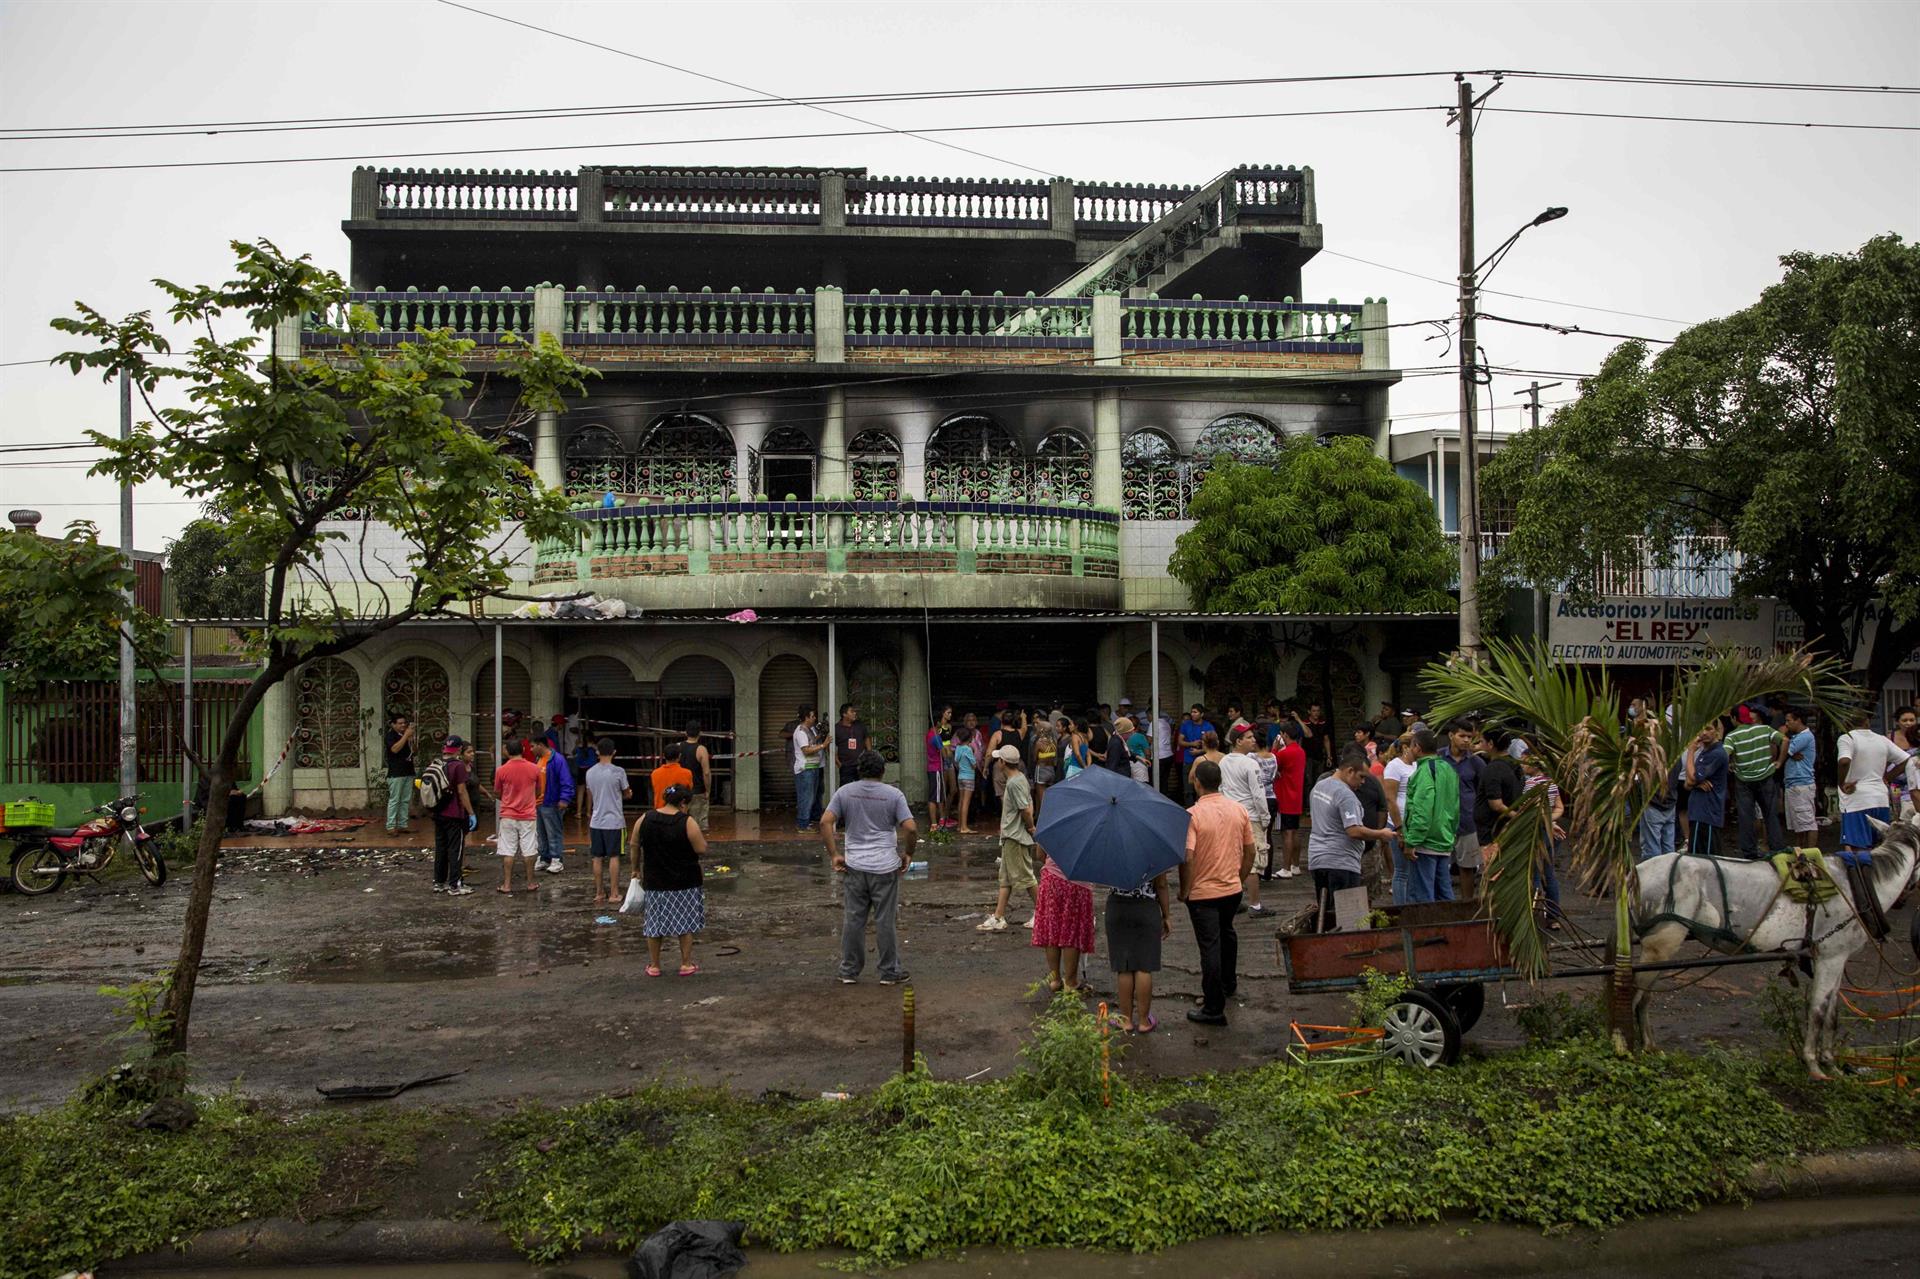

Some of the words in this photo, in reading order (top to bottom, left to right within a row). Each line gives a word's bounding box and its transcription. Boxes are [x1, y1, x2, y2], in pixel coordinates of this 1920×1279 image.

[1557, 598, 1647, 618] Accesorios
[1650, 605, 1661, 618] y
[1552, 645, 1614, 659] ELECTRICO
